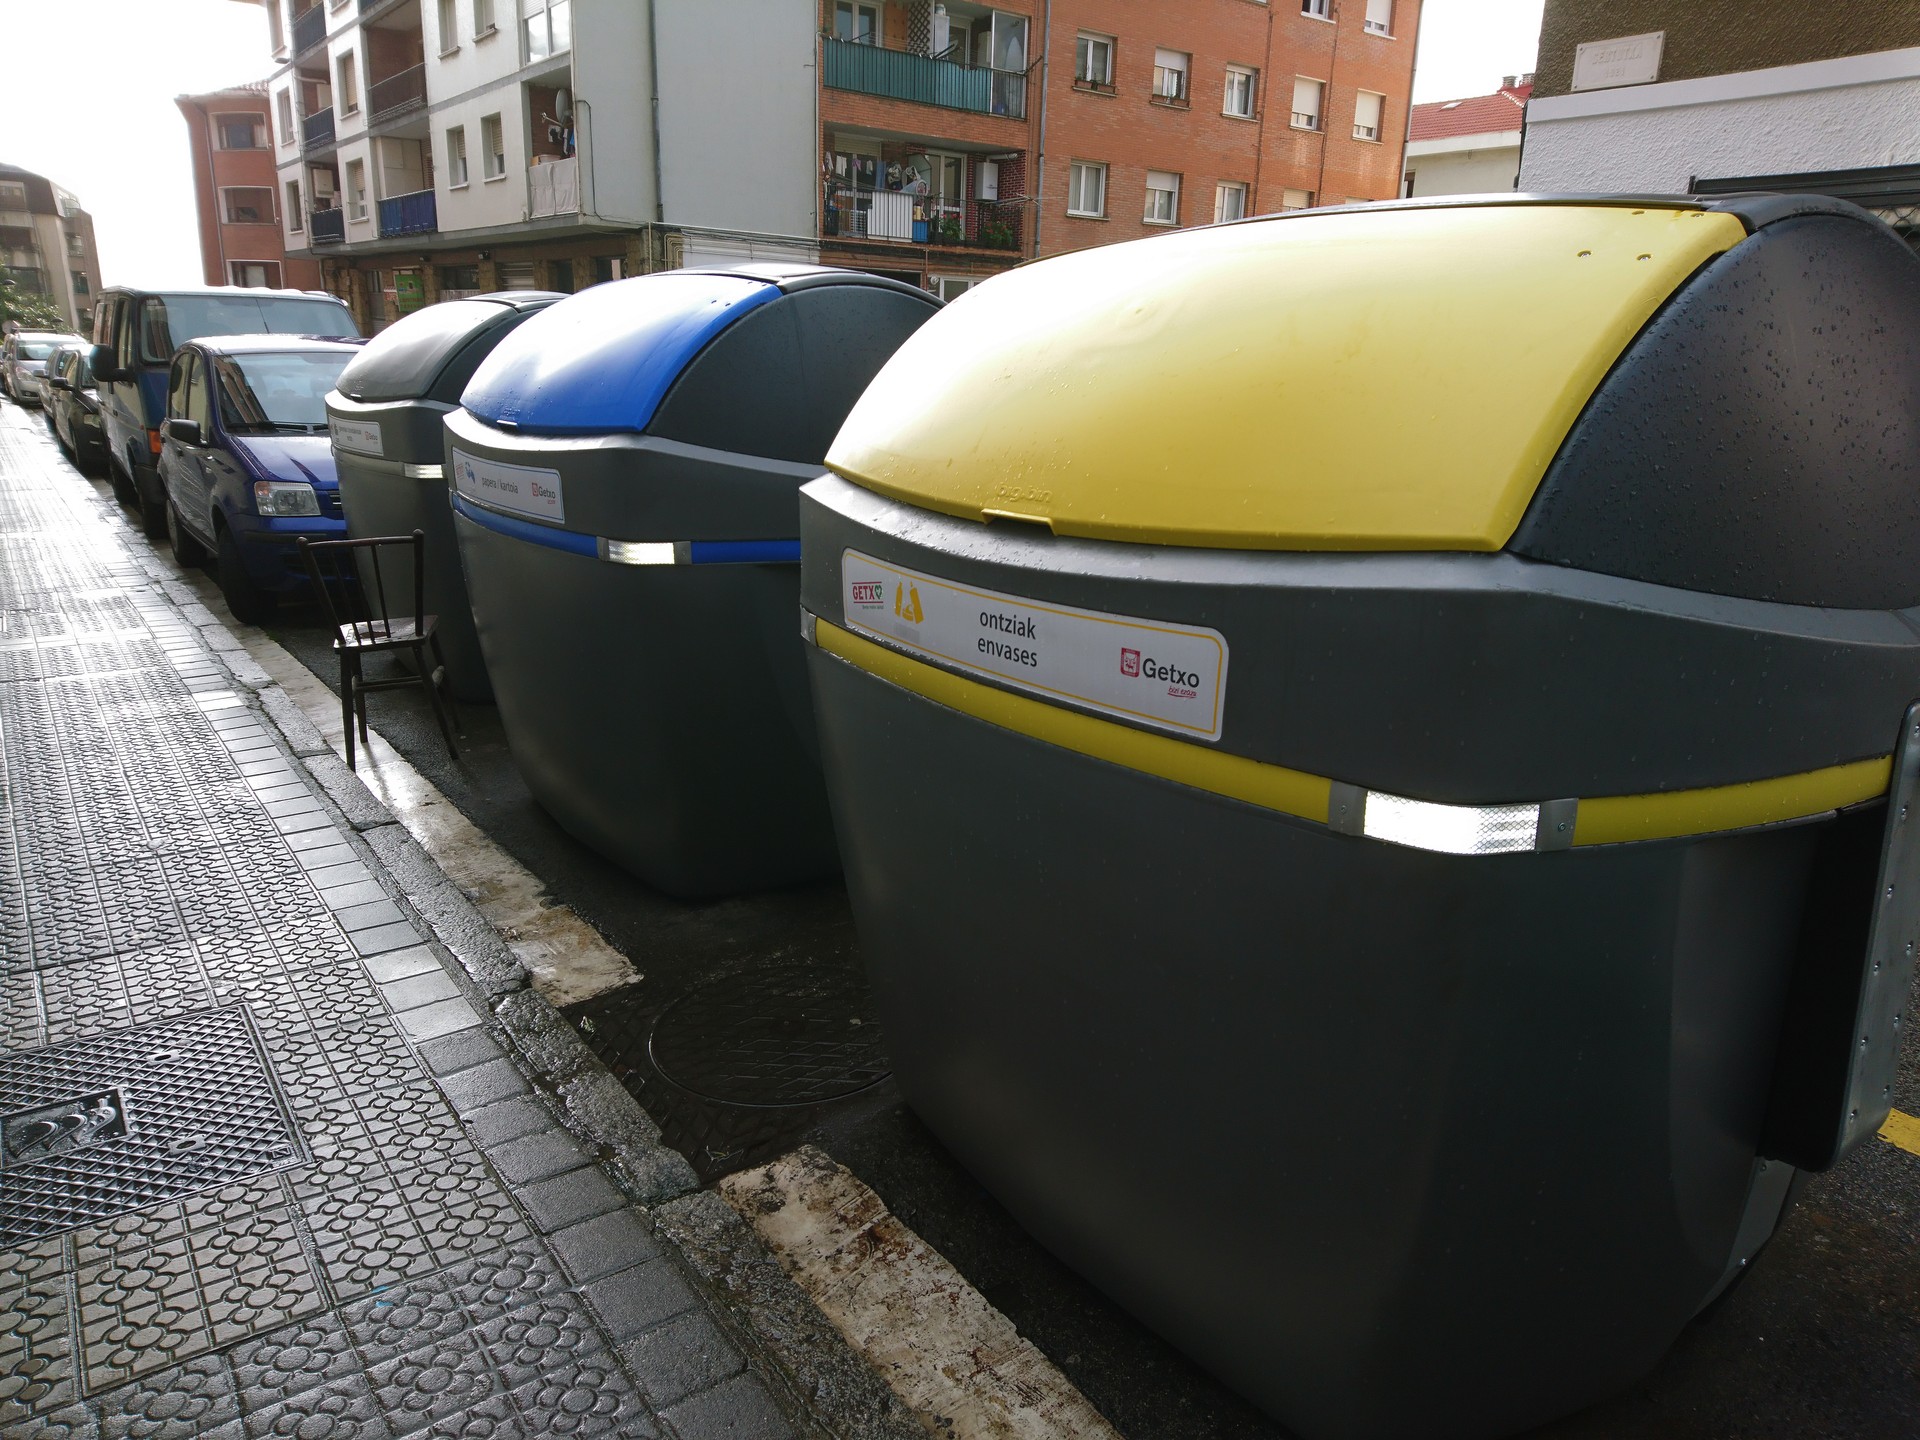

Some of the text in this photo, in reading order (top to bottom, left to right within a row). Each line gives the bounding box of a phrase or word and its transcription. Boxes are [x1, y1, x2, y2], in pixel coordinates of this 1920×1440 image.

[538, 486, 556, 499] Getxo
[980, 611, 1036, 640] ontziak
[977, 637, 1037, 667] envases
[1142, 657, 1200, 688] Getxo
